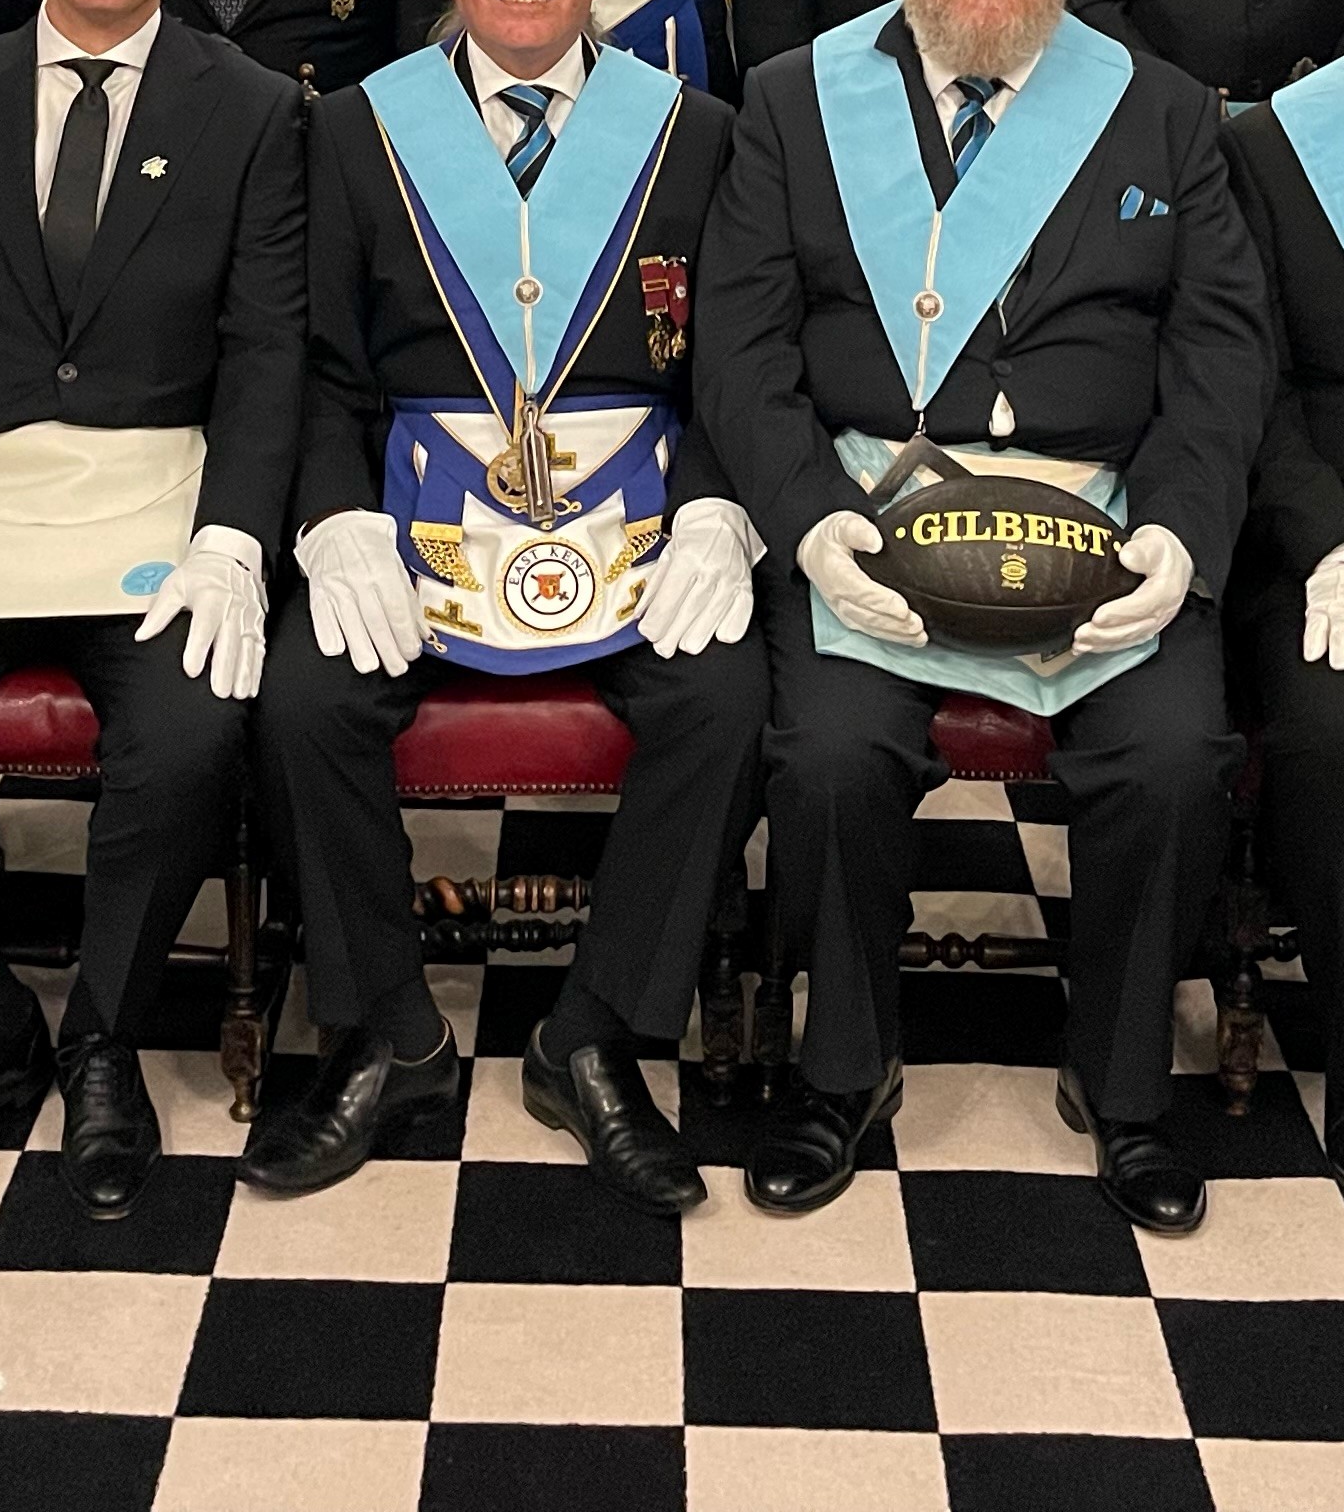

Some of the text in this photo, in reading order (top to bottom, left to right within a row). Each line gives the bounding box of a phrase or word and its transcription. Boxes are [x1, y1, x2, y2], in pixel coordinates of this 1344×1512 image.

[912, 510, 1113, 557] GILBERT
[508, 545, 590, 586] EAST KENT
